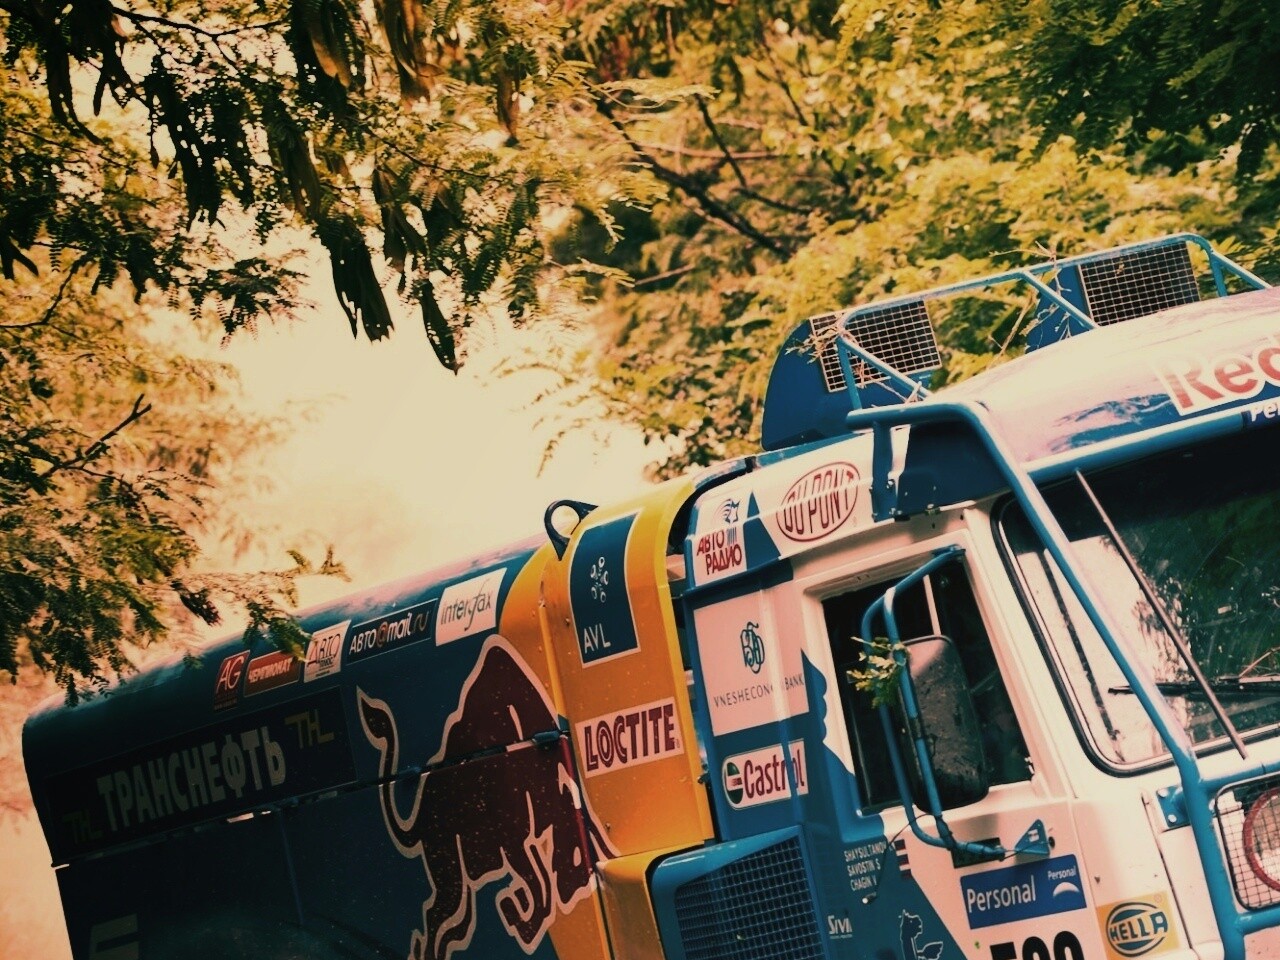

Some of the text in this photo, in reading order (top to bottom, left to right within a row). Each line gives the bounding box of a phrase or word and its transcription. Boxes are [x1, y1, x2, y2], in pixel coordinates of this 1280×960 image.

[697, 528, 725, 556] АВТО
[705, 543, 743, 575] РАДИО
[584, 622, 611, 654] AVL
[584, 703, 676, 772] LOCTITE
[97, 726, 286, 832] ТРАНСНЕФТЬ
[850, 876, 873, 891] CHAGIN
[1048, 865, 1077, 880] Personal
[966, 875, 1036, 914] Personal
[1109, 911, 1168, 942] HELLA
